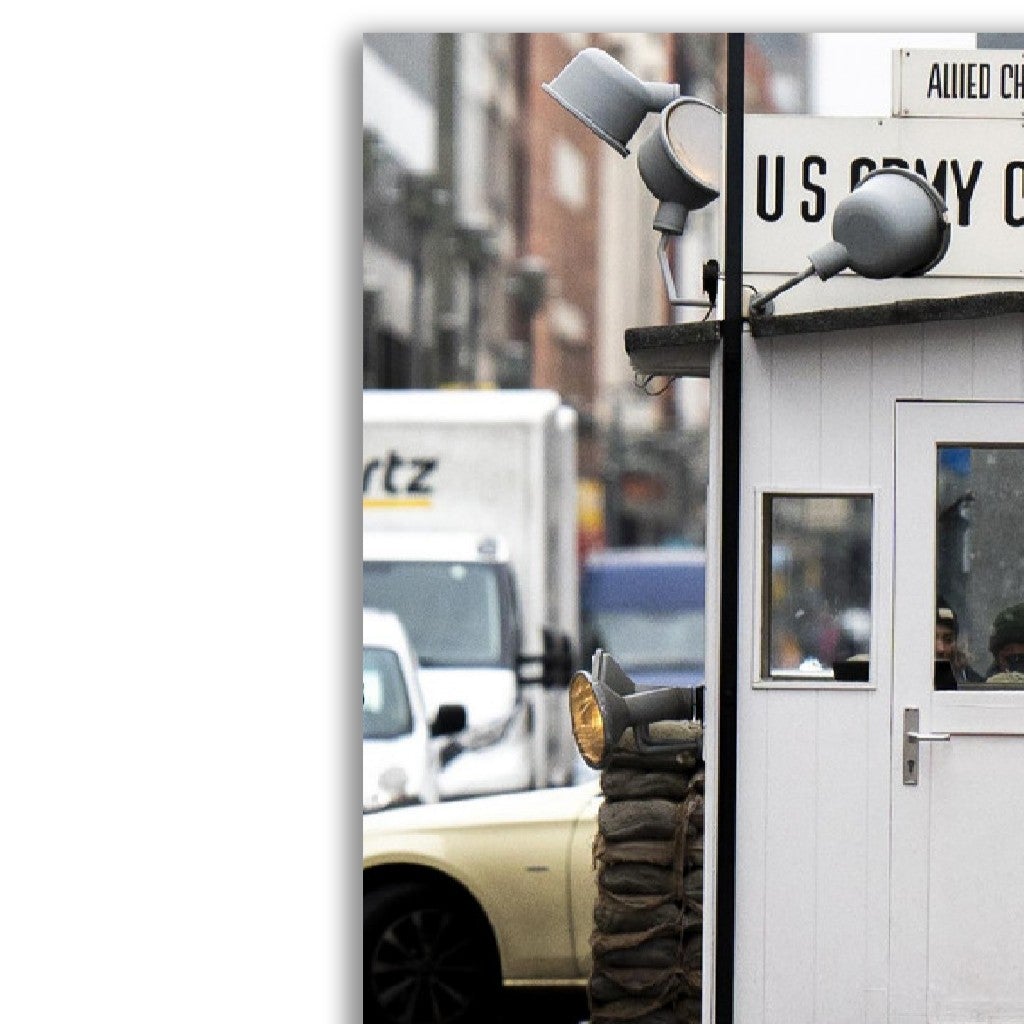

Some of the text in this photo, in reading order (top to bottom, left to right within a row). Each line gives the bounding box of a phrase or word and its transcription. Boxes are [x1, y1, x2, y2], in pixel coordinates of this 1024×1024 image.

[926, 63, 991, 99] ALLIED
[757, 154, 784, 223] U
[801, 155, 827, 223] S
